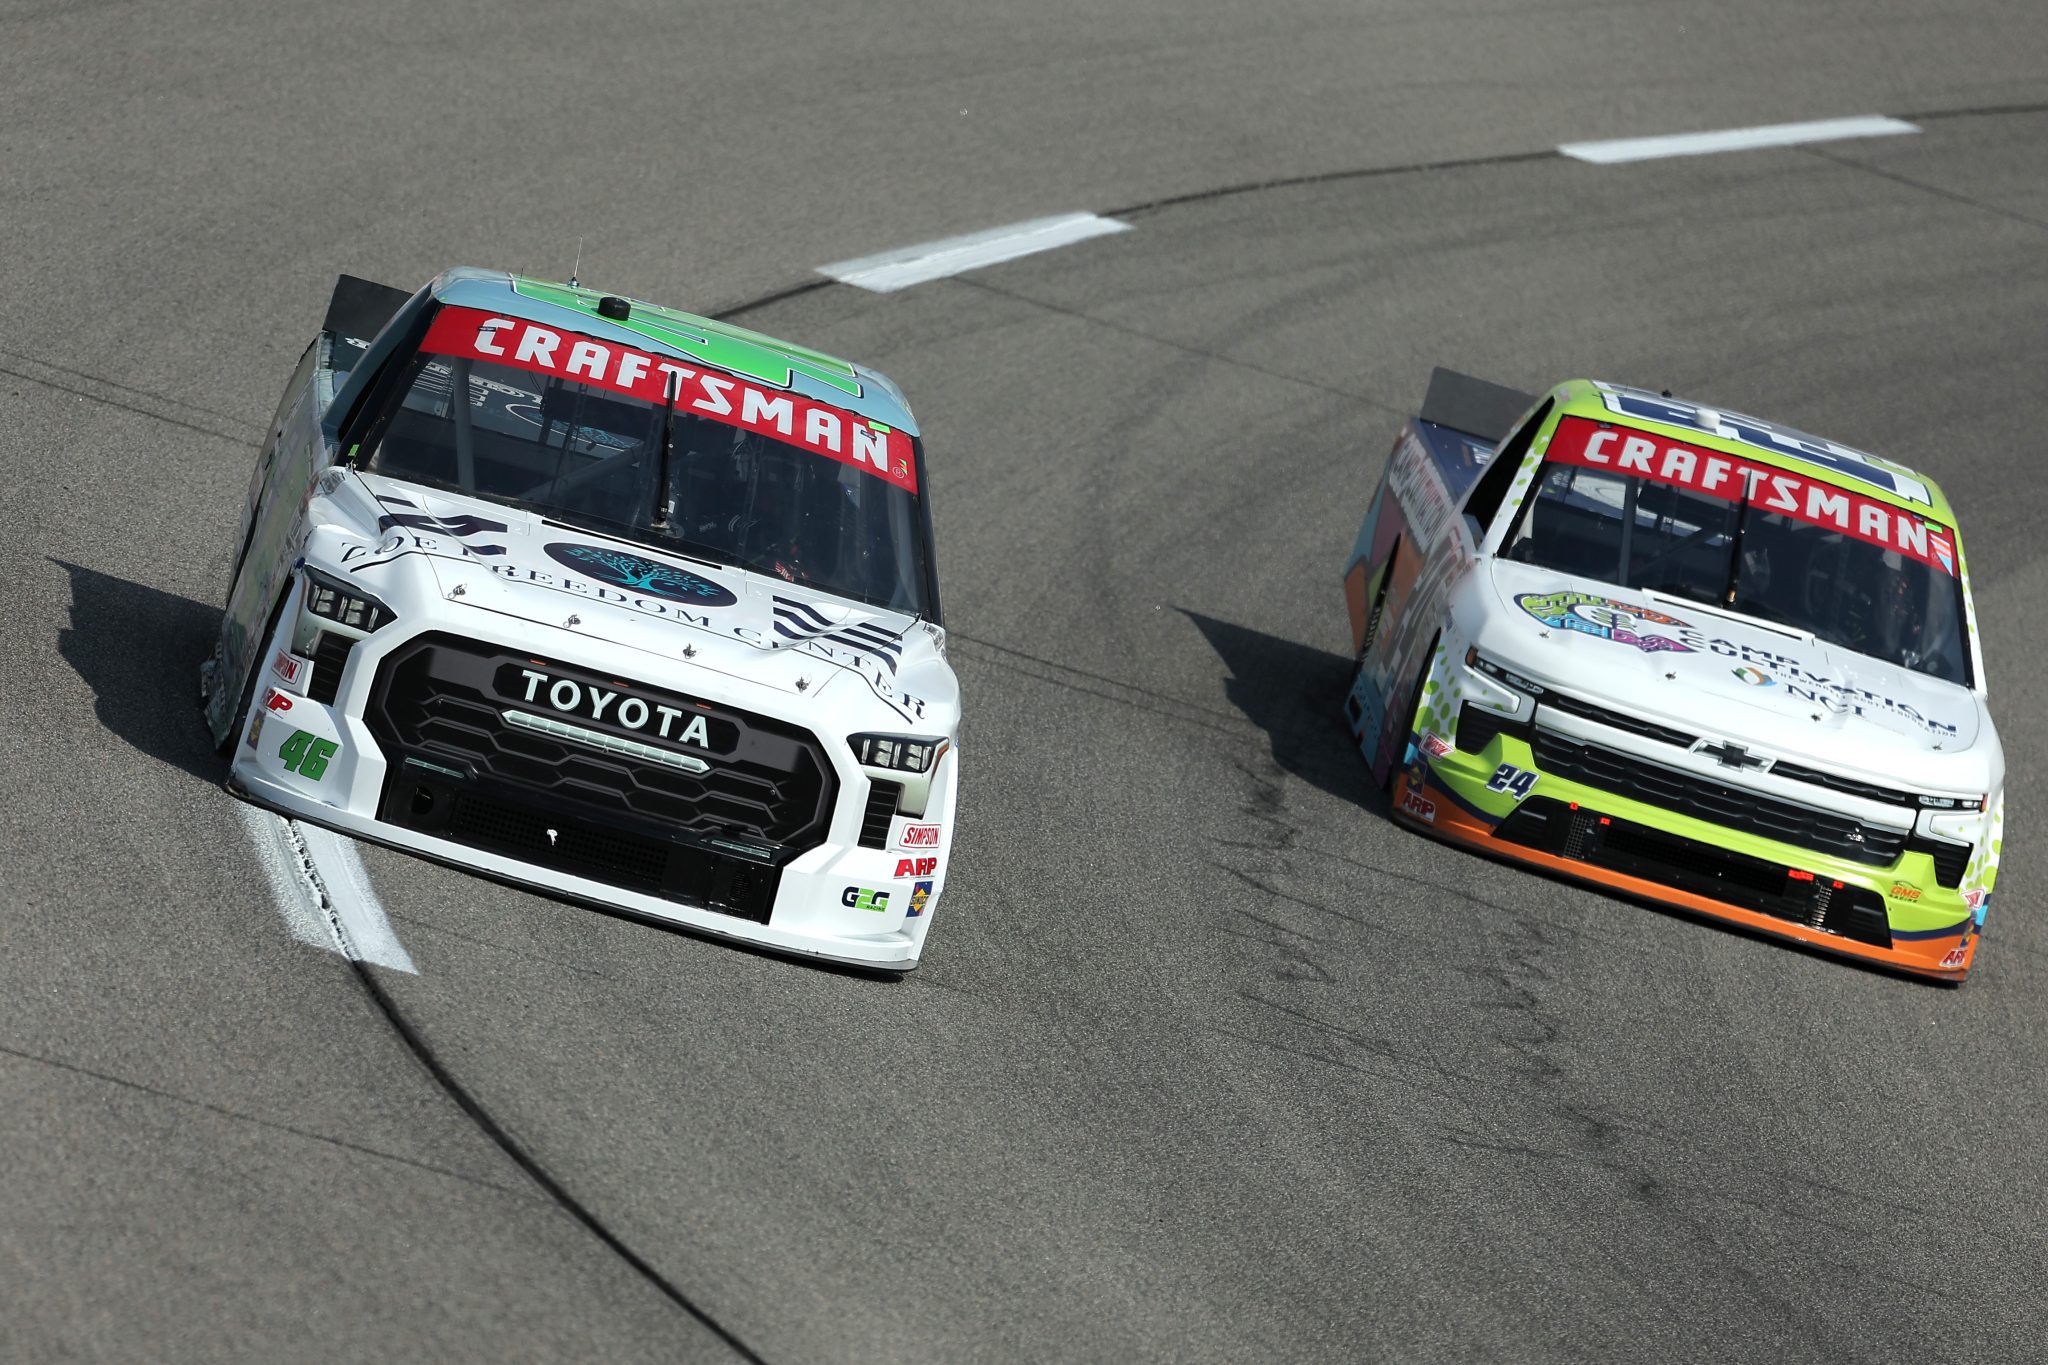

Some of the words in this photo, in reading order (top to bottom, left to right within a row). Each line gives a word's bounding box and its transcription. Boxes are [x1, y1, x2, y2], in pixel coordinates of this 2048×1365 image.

[474, 317, 888, 473] CRAFTSMAN
[1583, 431, 1929, 558] CRAFTSMAN
[341, 536, 438, 563] ZOE
[733, 626, 928, 720] CNTER
[1679, 629, 1800, 665] CAMP
[522, 669, 709, 750] TOYOTA
[279, 729, 339, 781] 46
[1485, 762, 1541, 801] 24
[903, 826, 940, 845] SIMPSON
[893, 857, 938, 877] ARP
